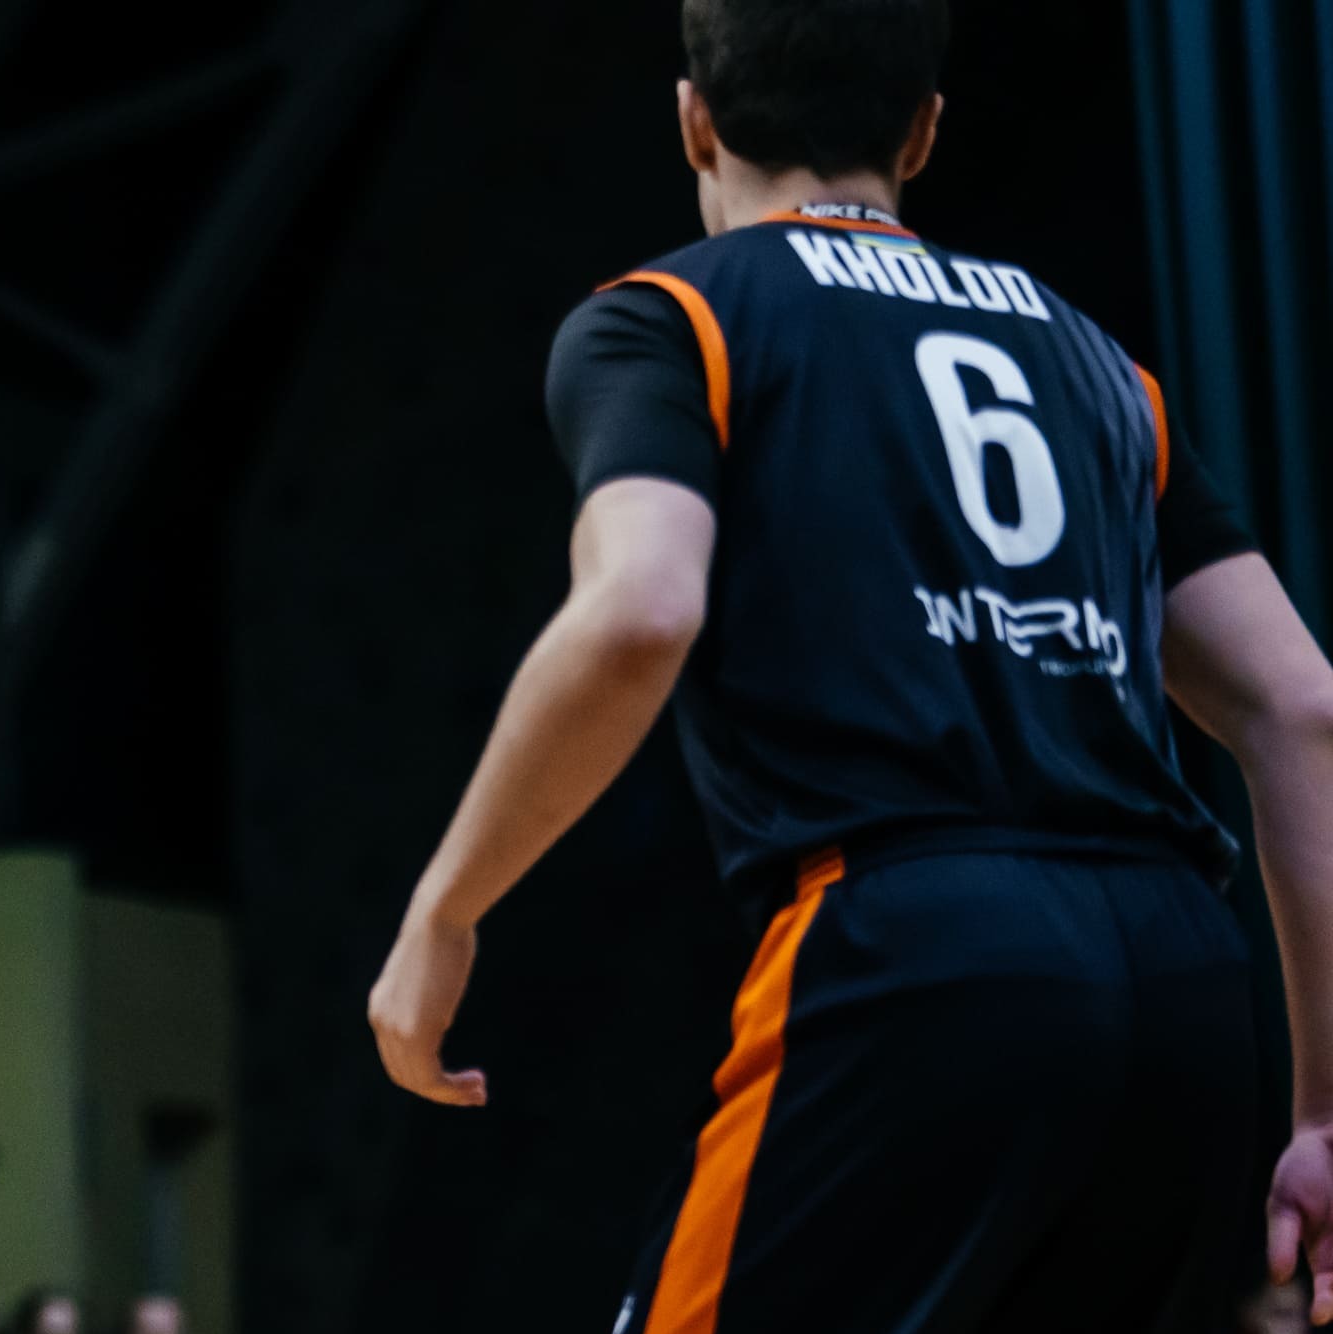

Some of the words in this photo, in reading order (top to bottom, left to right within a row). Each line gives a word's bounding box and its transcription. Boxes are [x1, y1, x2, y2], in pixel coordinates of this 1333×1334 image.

[800, 203, 861, 219] NIKE
[786, 230, 1052, 321] KHOLOD
[914, 331, 1065, 567] 6
